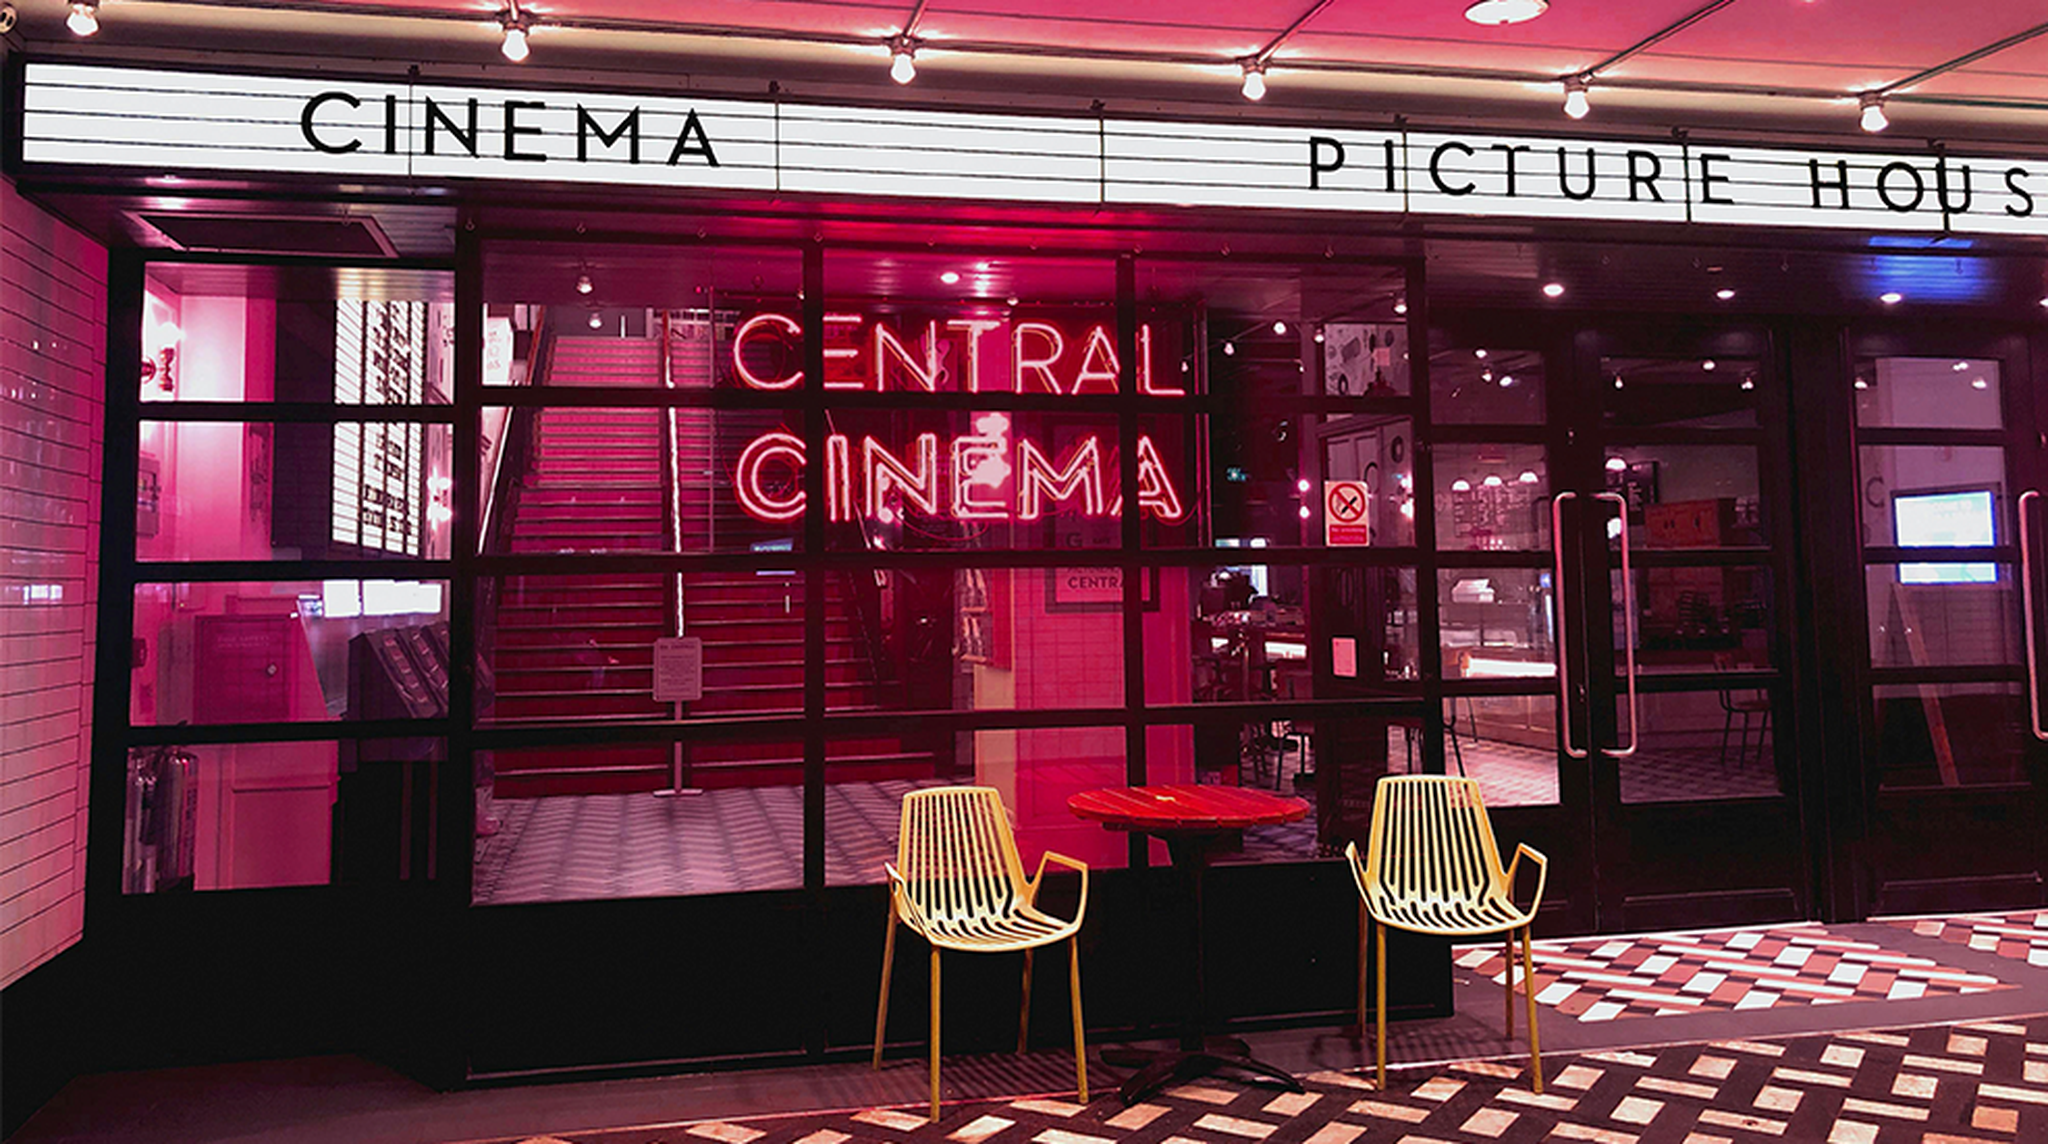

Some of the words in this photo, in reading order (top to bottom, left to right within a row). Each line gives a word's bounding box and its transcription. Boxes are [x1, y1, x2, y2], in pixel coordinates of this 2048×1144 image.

[301, 92, 720, 167] CINEMA
[1309, 136, 1734, 204] PICTURE
[1808, 159, 2034, 218] HOUS
[733, 313, 1186, 395] CENTRAL
[735, 432, 1184, 521] CINEMA
[1067, 576, 1123, 589] CENTR
